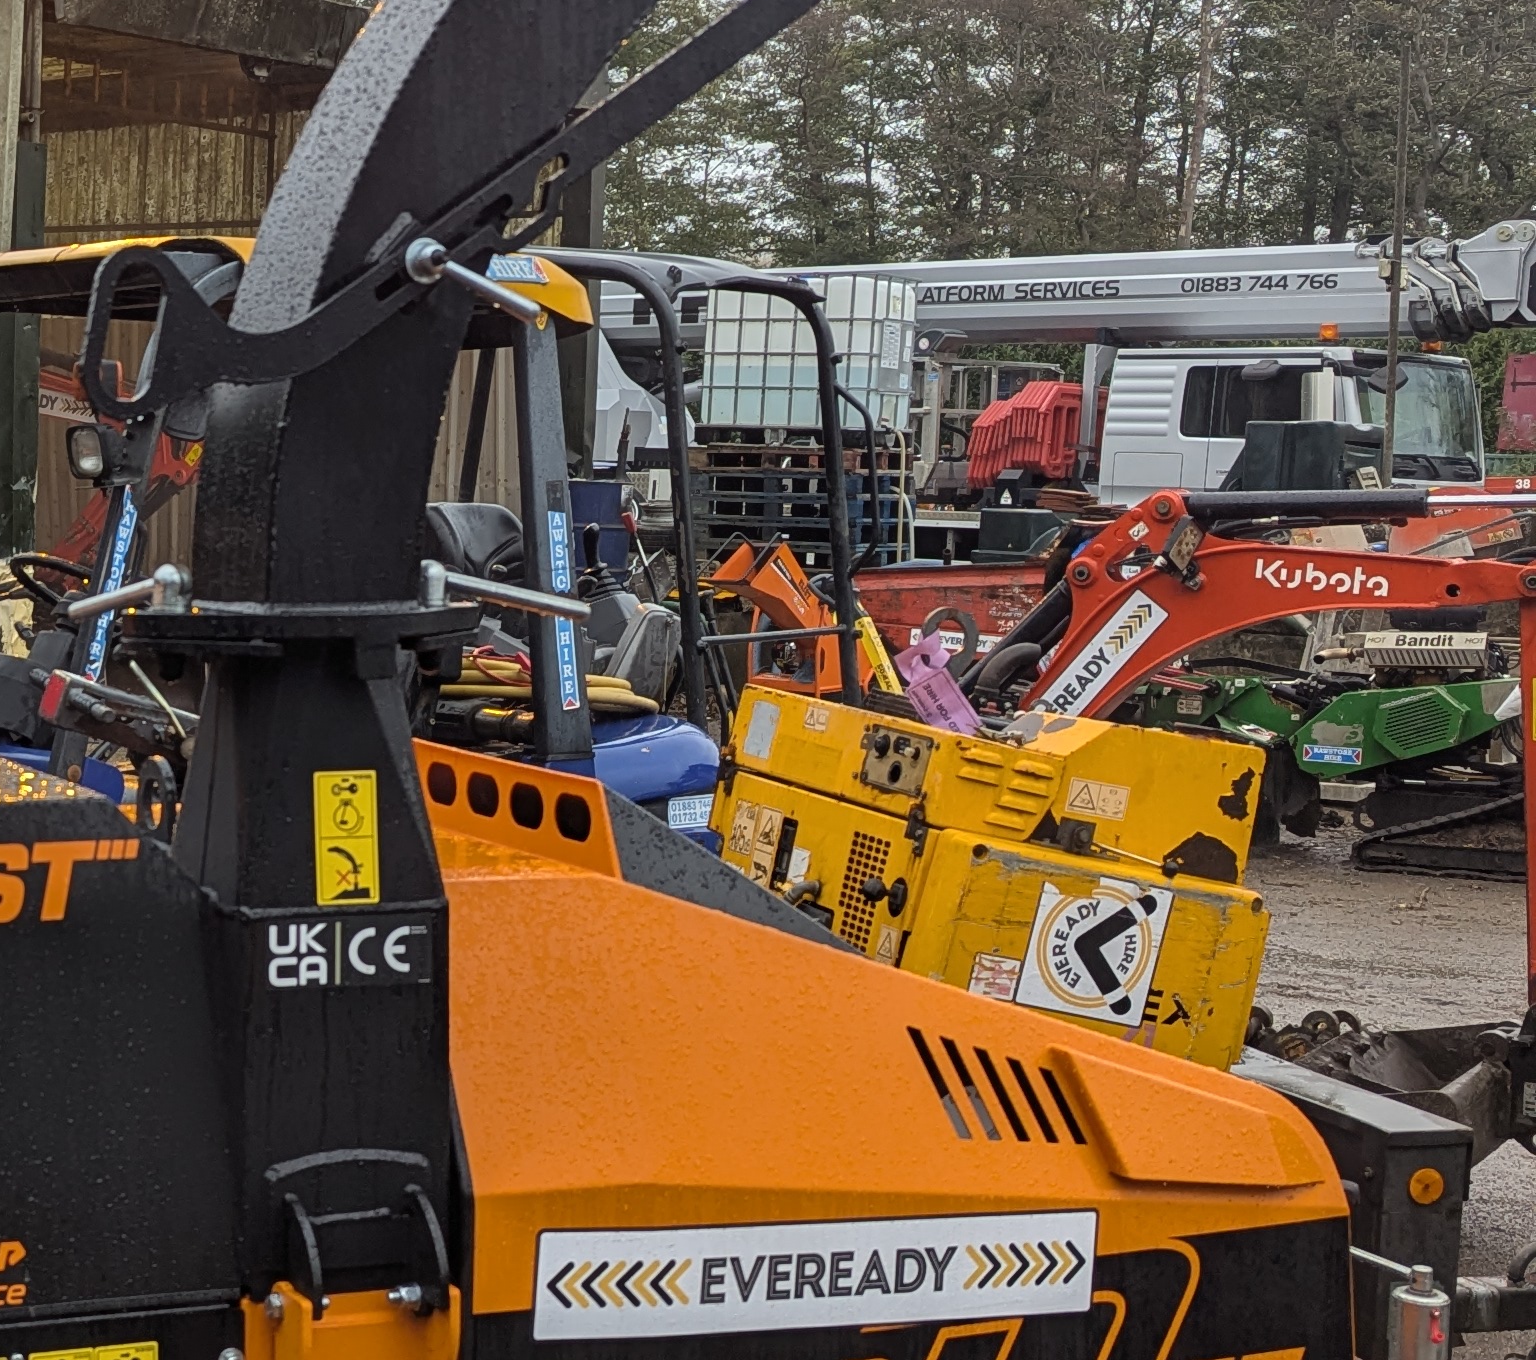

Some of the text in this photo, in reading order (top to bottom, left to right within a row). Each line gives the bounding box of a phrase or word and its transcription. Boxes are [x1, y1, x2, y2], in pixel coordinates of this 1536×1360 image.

[491, 260, 537, 279] HIRE
[1014, 280, 1122, 301] SERVICES
[1180, 273, 1339, 293] 01883 744 766
[1515, 478, 1531, 490] 38
[1254, 557, 1390, 598] Kubota
[1395, 634, 1455, 648] Bandit
[1464, 637, 1486, 645] HOT
[559, 631, 575, 694] HIRE
[922, 682, 941, 704] HIRE
[935, 702, 953, 722] FOR
[670, 800, 697, 813] 01883
[671, 811, 698, 824] 01732
[268, 922, 328, 955] UK
[1052, 900, 1138, 989] EVEREADY HIRE
[268, 955, 328, 988] CA
[699, 1245, 958, 1305] EVEREADY
